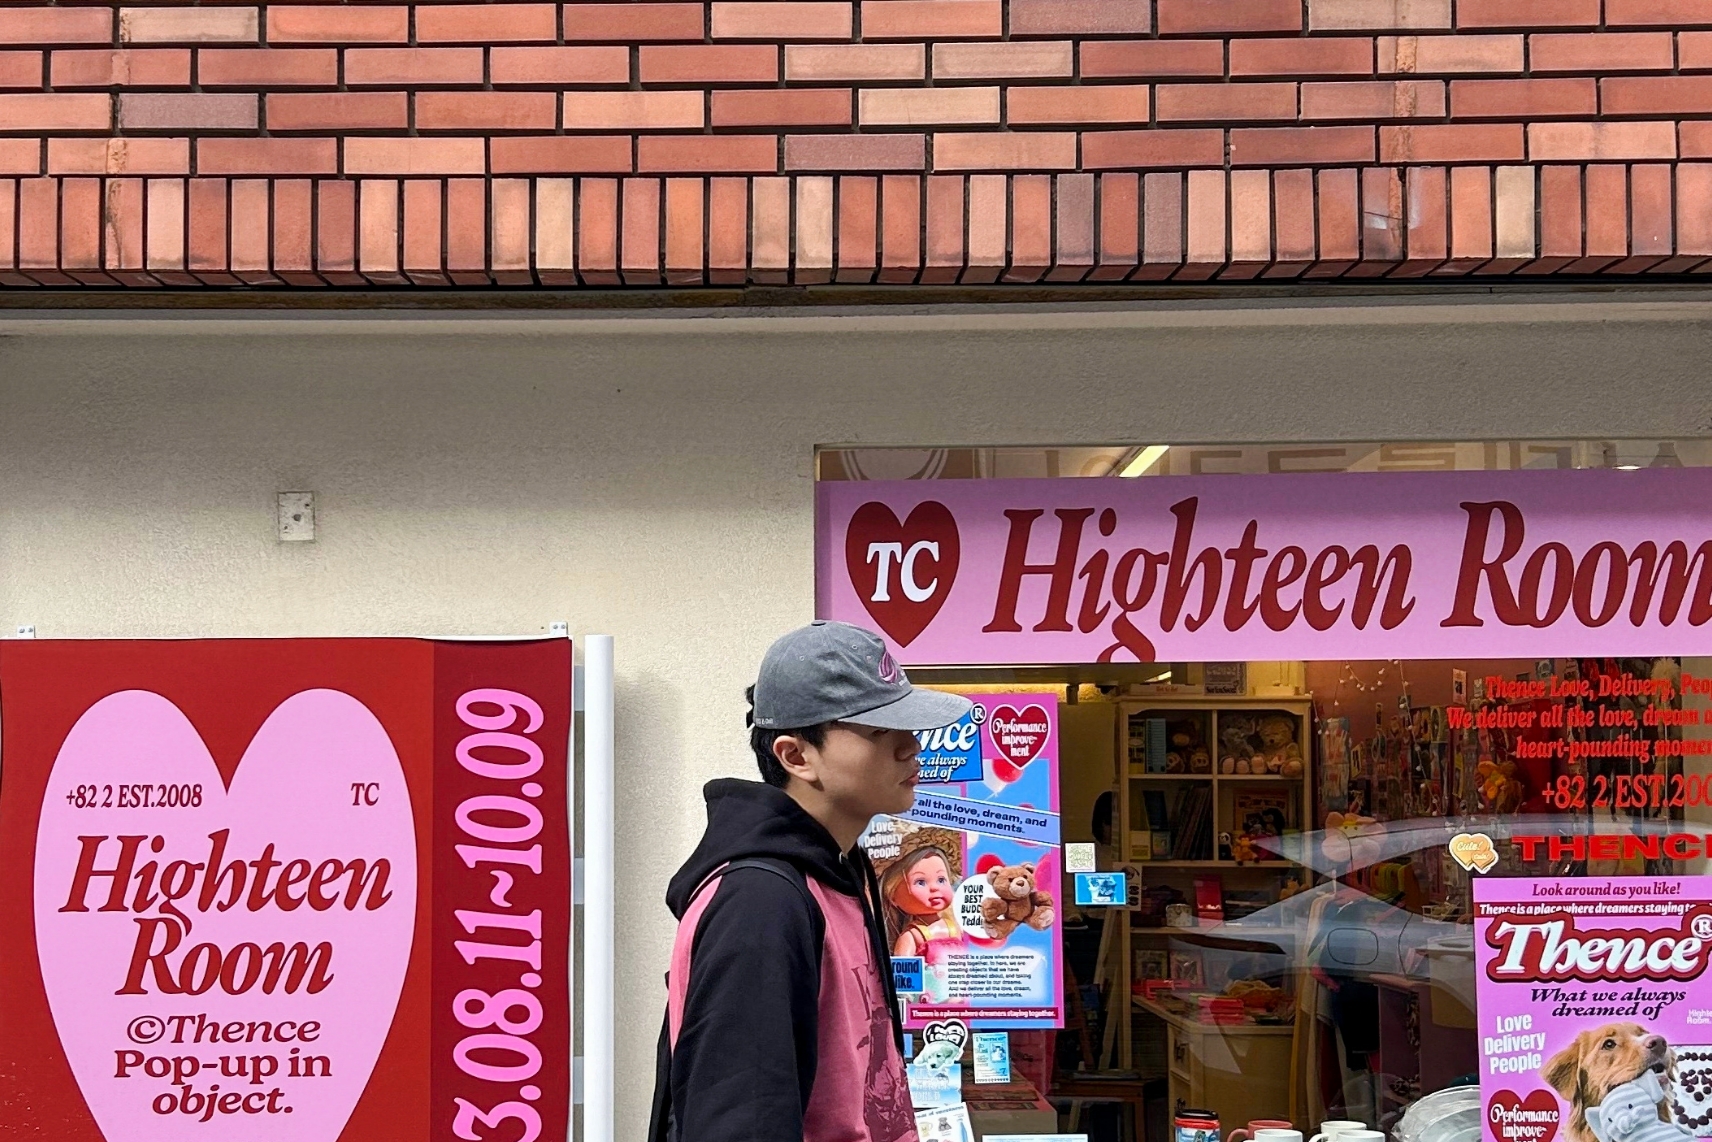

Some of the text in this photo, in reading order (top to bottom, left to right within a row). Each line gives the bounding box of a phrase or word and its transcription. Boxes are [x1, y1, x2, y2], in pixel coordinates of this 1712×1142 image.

[866, 496, 1712, 663] TC Highteen Room
[1485, 674, 1546, 699] Thence
[1550, 674, 1594, 701] Love,
[1598, 673, 1675, 700] Delivery,
[992, 718, 1048, 734] Performance
[1447, 703, 1699, 730] We deliver all the love, dream
[1010, 745, 1030, 758] ment
[1516, 733, 1712, 763] heart-pounding mome
[926, 754, 968, 771] always
[940, 767, 955, 782] of
[66, 784, 203, 809] +82 2 EST.2008
[350, 783, 380, 807] TC
[1541, 774, 1586, 809] +82
[1592, 775, 1609, 809] 2
[917, 799, 1048, 828] all the love, dream, and
[871, 820, 893, 834] Love
[967, 817, 1026, 834] moments.
[863, 832, 902, 849] Delivery
[1511, 833, 1712, 862] THENC
[59, 828, 394, 937] Highteen
[962, 884, 984, 894] YOUR
[1532, 881, 1681, 899] Look around as you like!
[963, 894, 984, 904] BEST
[1479, 901, 1684, 917] Thence is a place where dreamers staying
[115, 916, 335, 997] Room
[1530, 987, 1686, 1006] What we always
[1552, 1001, 1665, 1021] dreamed of
[1496, 1013, 1532, 1034] Love
[1484, 1031, 1546, 1056] Delivery
[114, 1048, 333, 1086] Pop-up in
[1489, 1052, 1542, 1075] People
[152, 1086, 295, 1123] object.
[1490, 1103, 1559, 1124] Performance
[1502, 1123, 1547, 1139] improve-
